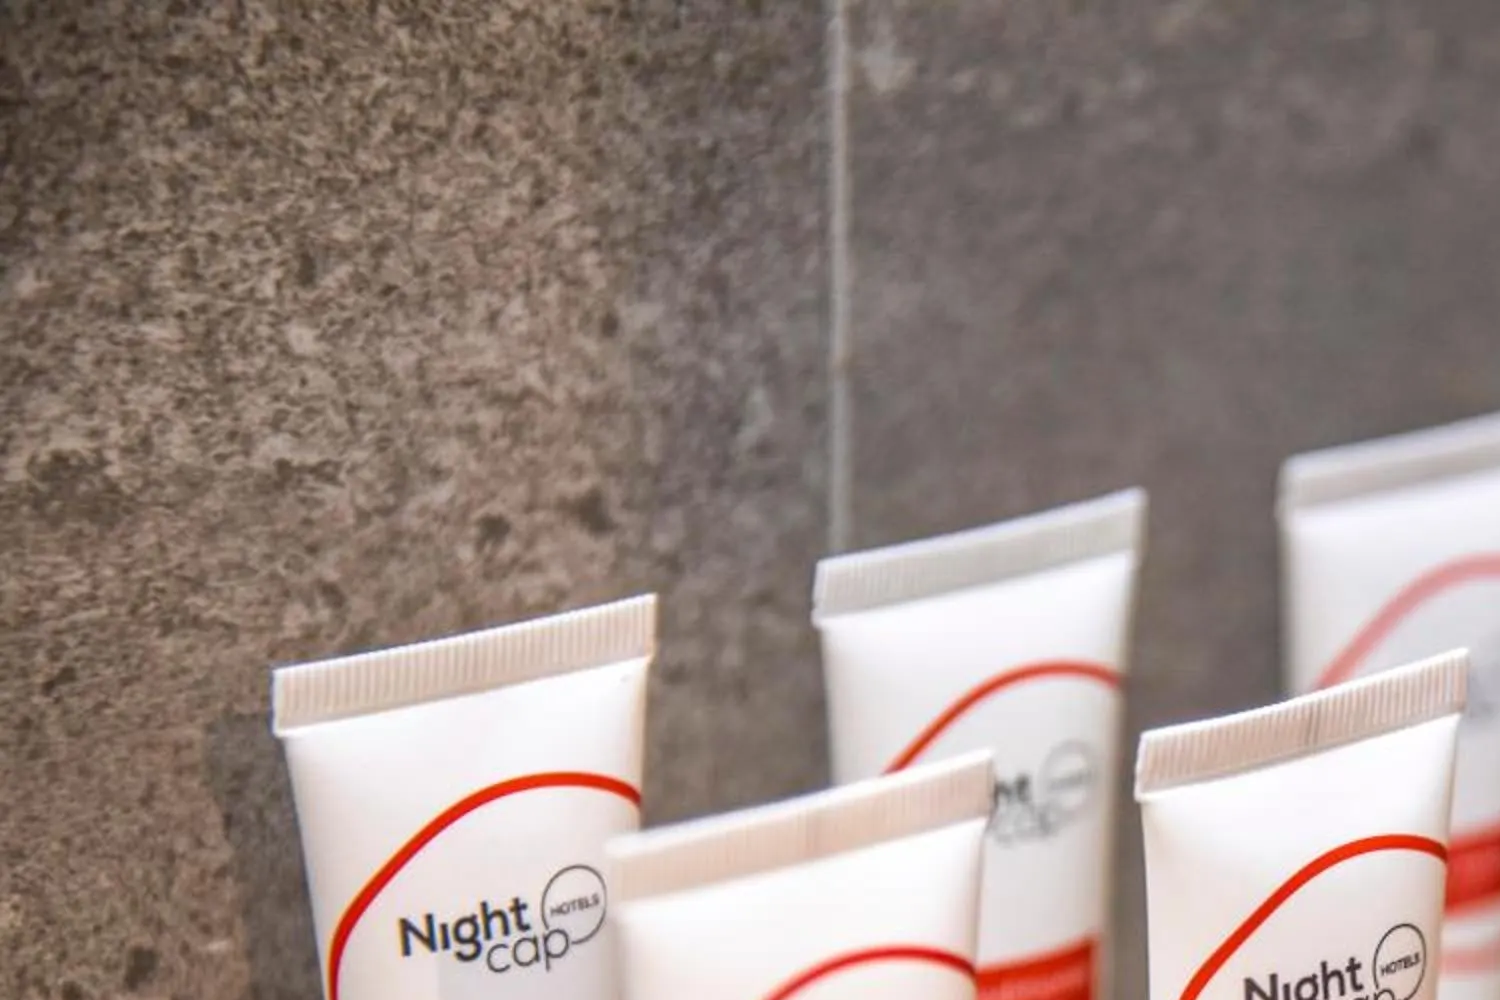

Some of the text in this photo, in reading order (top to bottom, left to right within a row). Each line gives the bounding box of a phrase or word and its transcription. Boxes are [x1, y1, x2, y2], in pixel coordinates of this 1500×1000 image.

[548, 892, 601, 918] HOTELS
[399, 897, 529, 961] Night
[486, 929, 571, 972] cap
[1379, 953, 1421, 976] HOTELS
